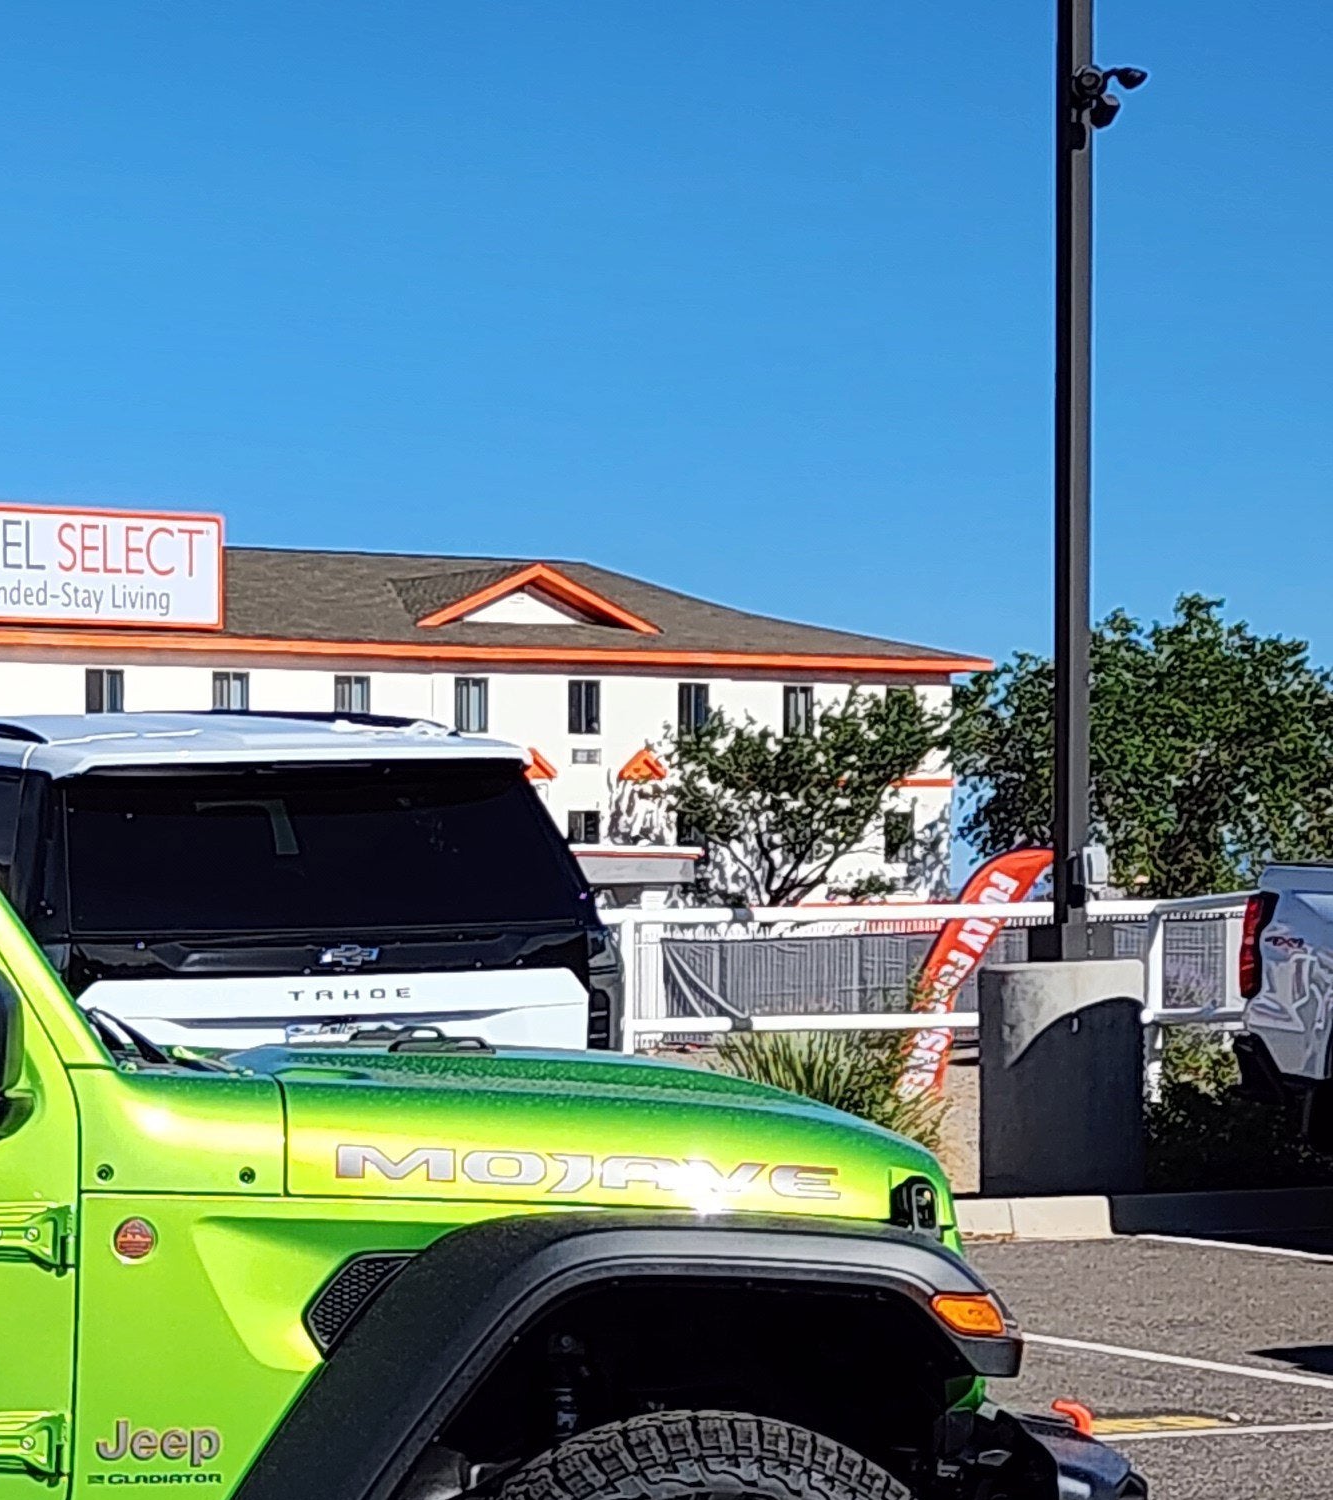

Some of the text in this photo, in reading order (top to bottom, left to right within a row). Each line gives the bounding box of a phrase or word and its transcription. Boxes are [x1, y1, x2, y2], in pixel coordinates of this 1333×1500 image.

[57, 521, 205, 578] SELECT
[111, 584, 171, 616] Living
[288, 987, 412, 1001] TAHOE
[335, 1144, 842, 1200] MOJAVE
[95, 1420, 221, 1468] Jeep
[107, 1473, 222, 1485] GLADIATOR
